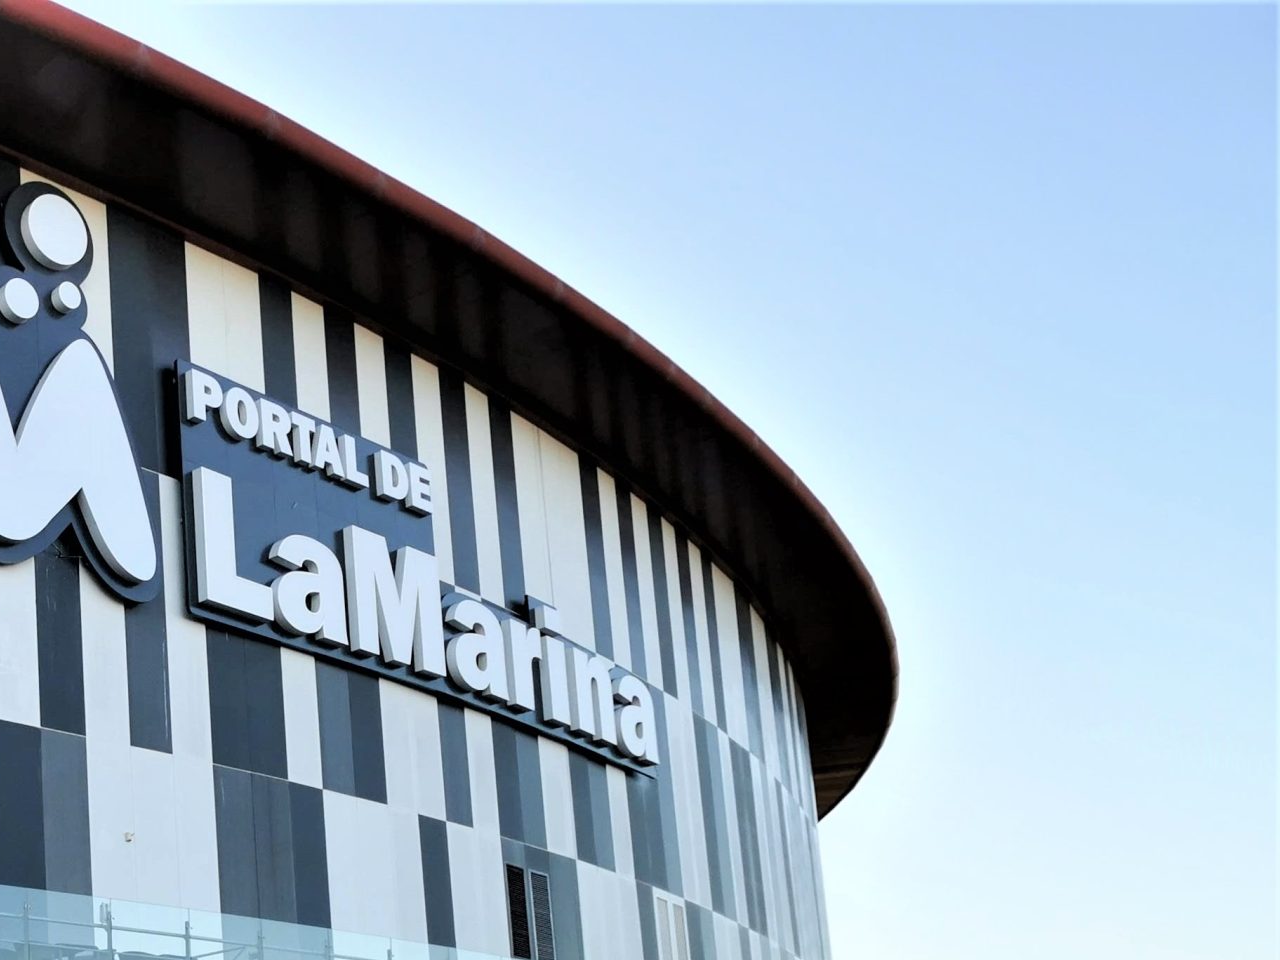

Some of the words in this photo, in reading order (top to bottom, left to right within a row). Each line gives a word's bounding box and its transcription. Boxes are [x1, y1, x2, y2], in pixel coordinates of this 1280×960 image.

[185, 367, 370, 493] PORTAL
[374, 449, 433, 517] DE
[192, 466, 660, 766] LaMarina
